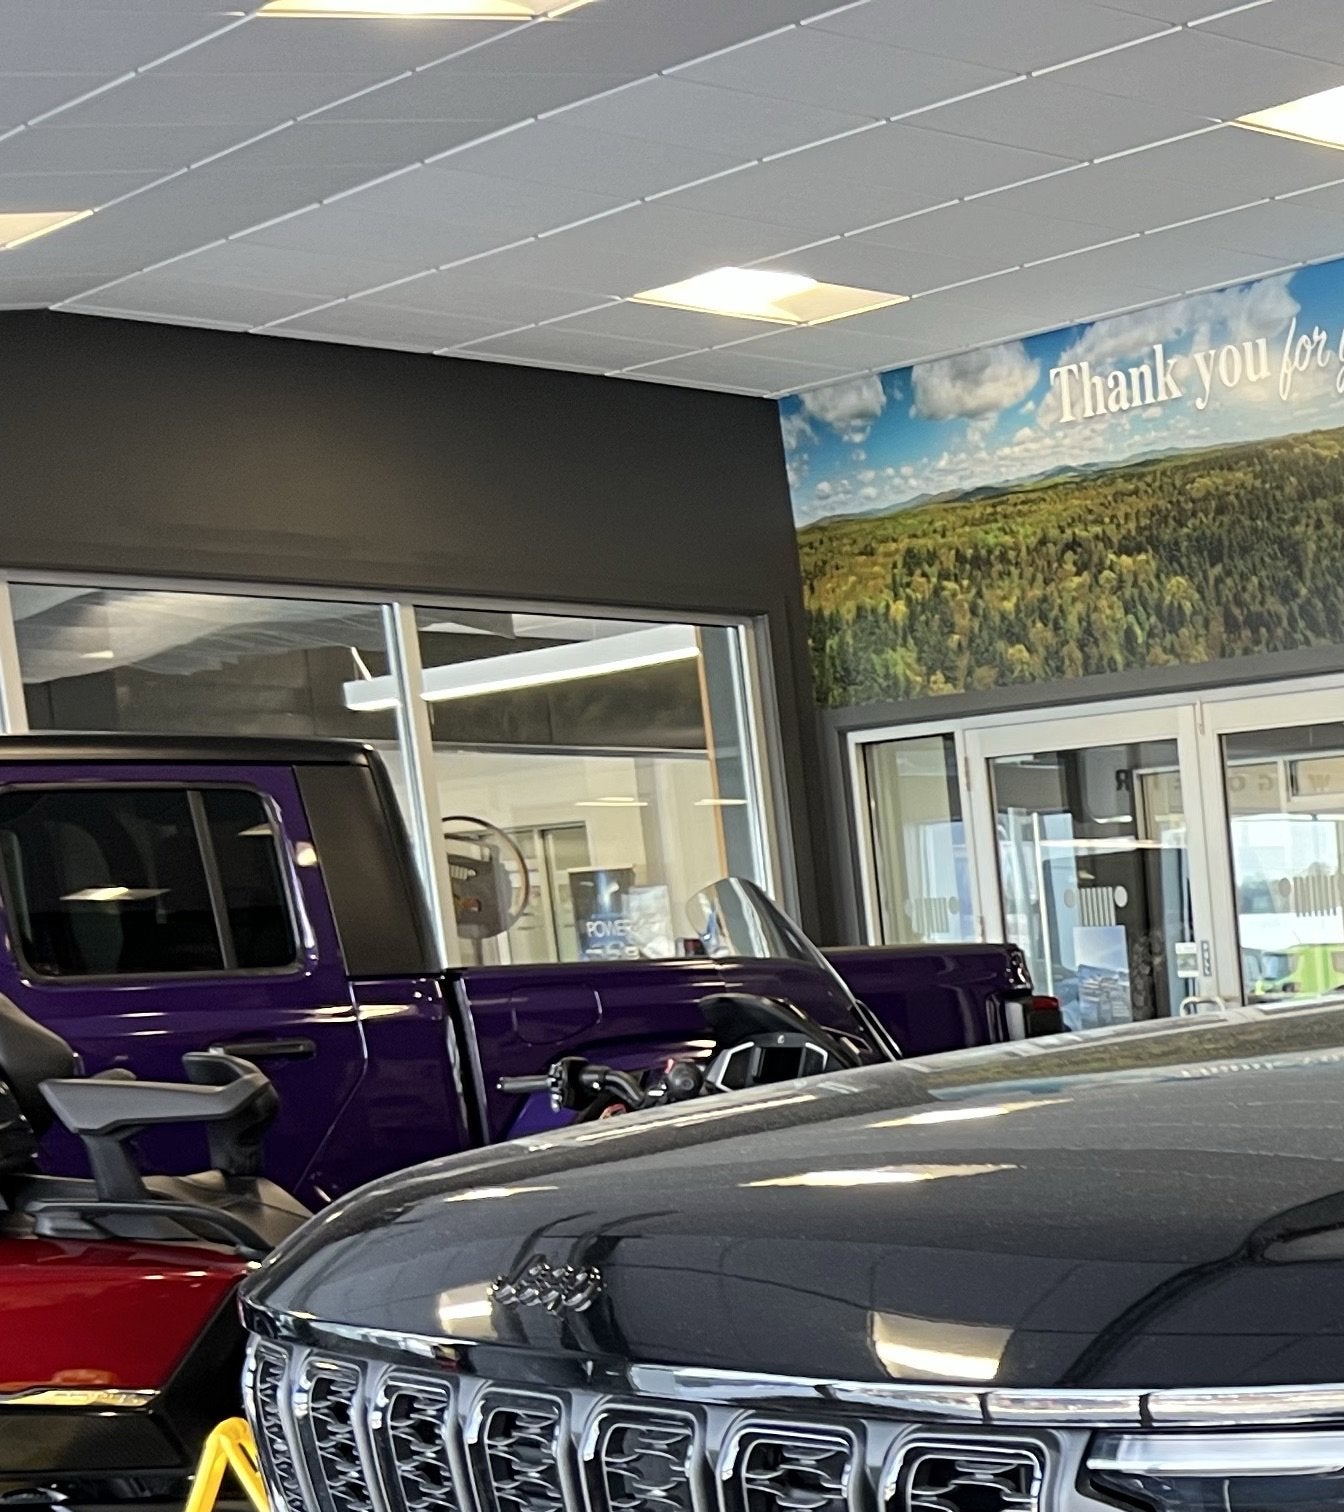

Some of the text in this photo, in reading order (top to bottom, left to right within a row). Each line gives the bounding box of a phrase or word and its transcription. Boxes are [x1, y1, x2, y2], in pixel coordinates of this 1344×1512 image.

[1049, 343, 1183, 424] Thank
[1193, 337, 1272, 411] you
[1278, 316, 1330, 401] for
